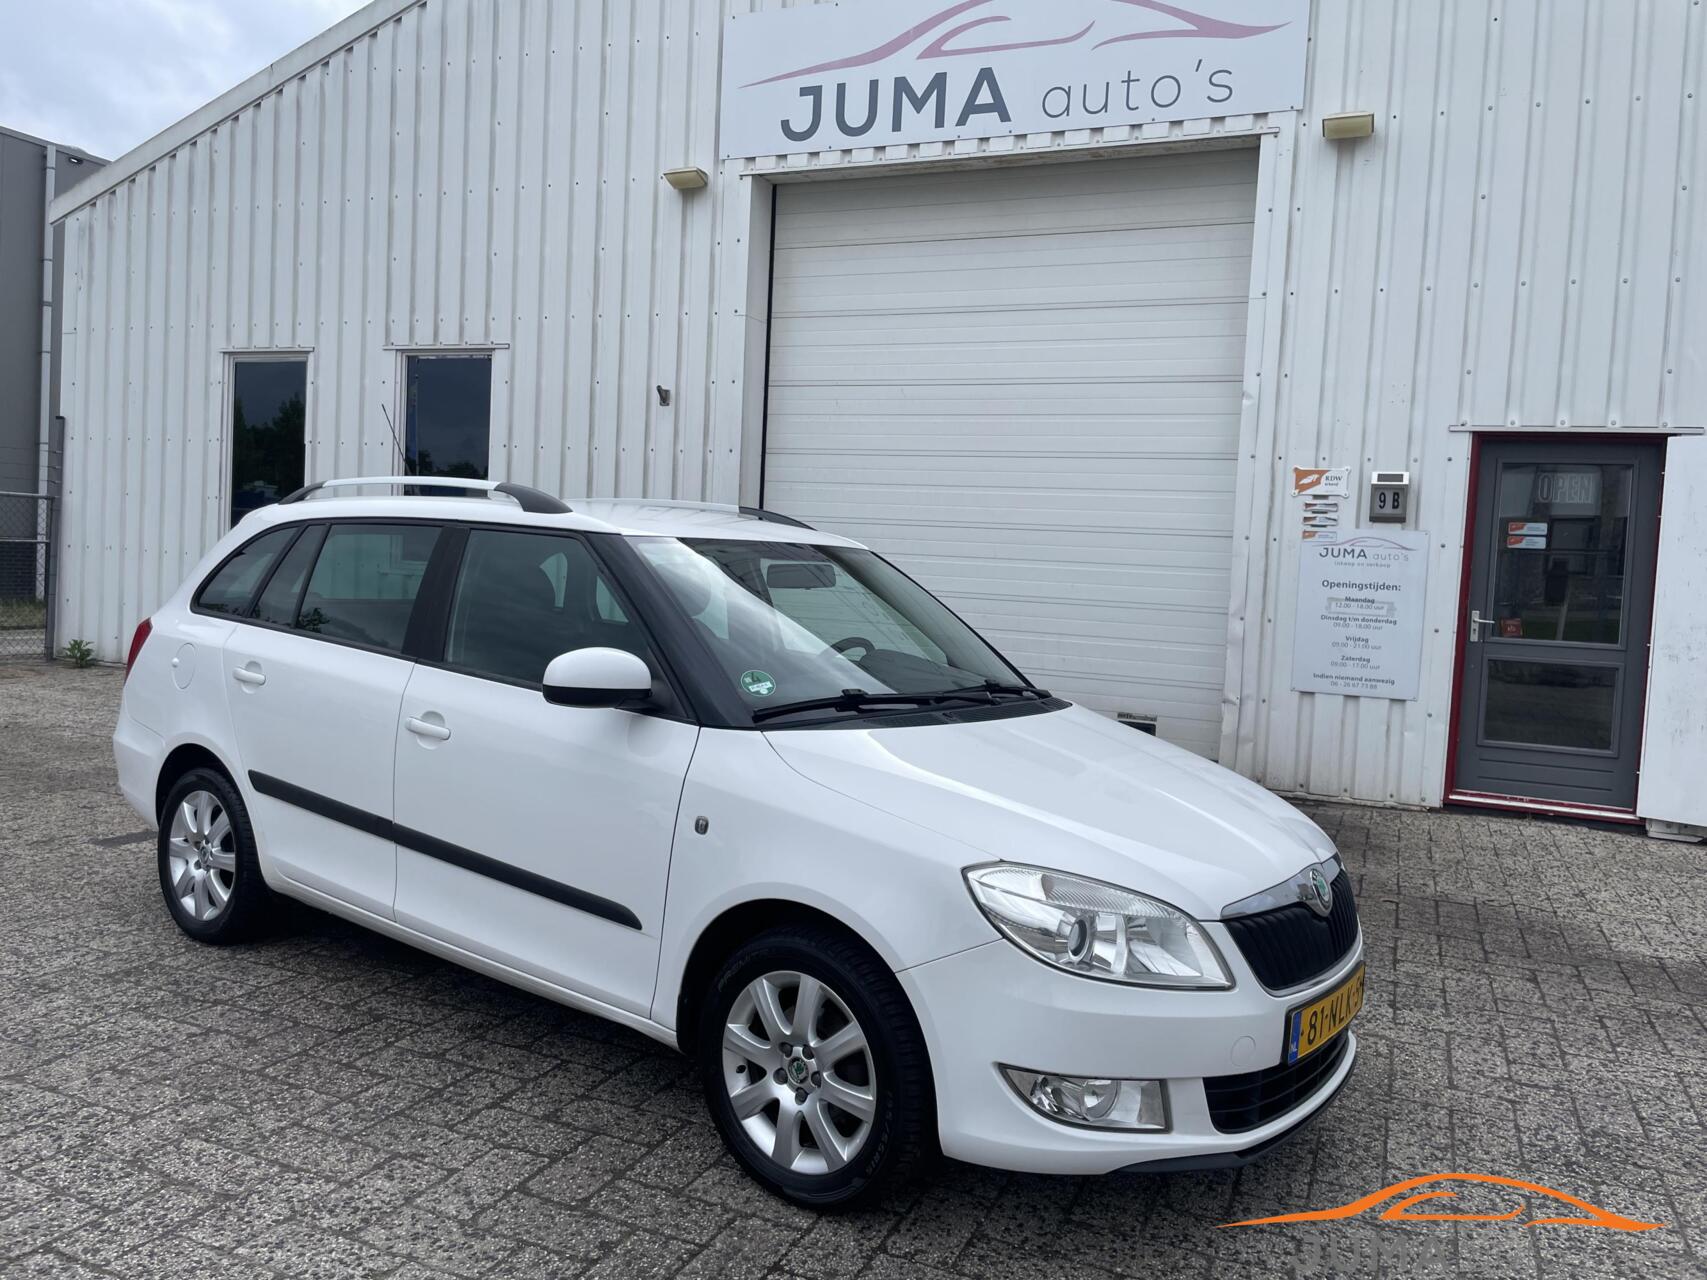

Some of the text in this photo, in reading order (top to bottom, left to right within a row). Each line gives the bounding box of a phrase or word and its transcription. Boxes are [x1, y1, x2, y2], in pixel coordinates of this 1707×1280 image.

[780, 59, 1235, 142] JUMA auto's
[1537, 473, 1593, 503] OPEN
[1379, 492, 1400, 509] 9 B
[1319, 547, 1368, 559] JUMA
[1321, 579, 1402, 593] Openingstijden:
[1344, 596, 1375, 605] Maandag
[1320, 614, 1346, 623] Dinsdag
[1360, 616, 1397, 626] donderdag
[1345, 635, 1369, 644] Vrijdag
[1340, 655, 1371, 664] Zaterdag
[1334, 674, 1363, 682] niemand
[1364, 677, 1395, 686] aanwezig
